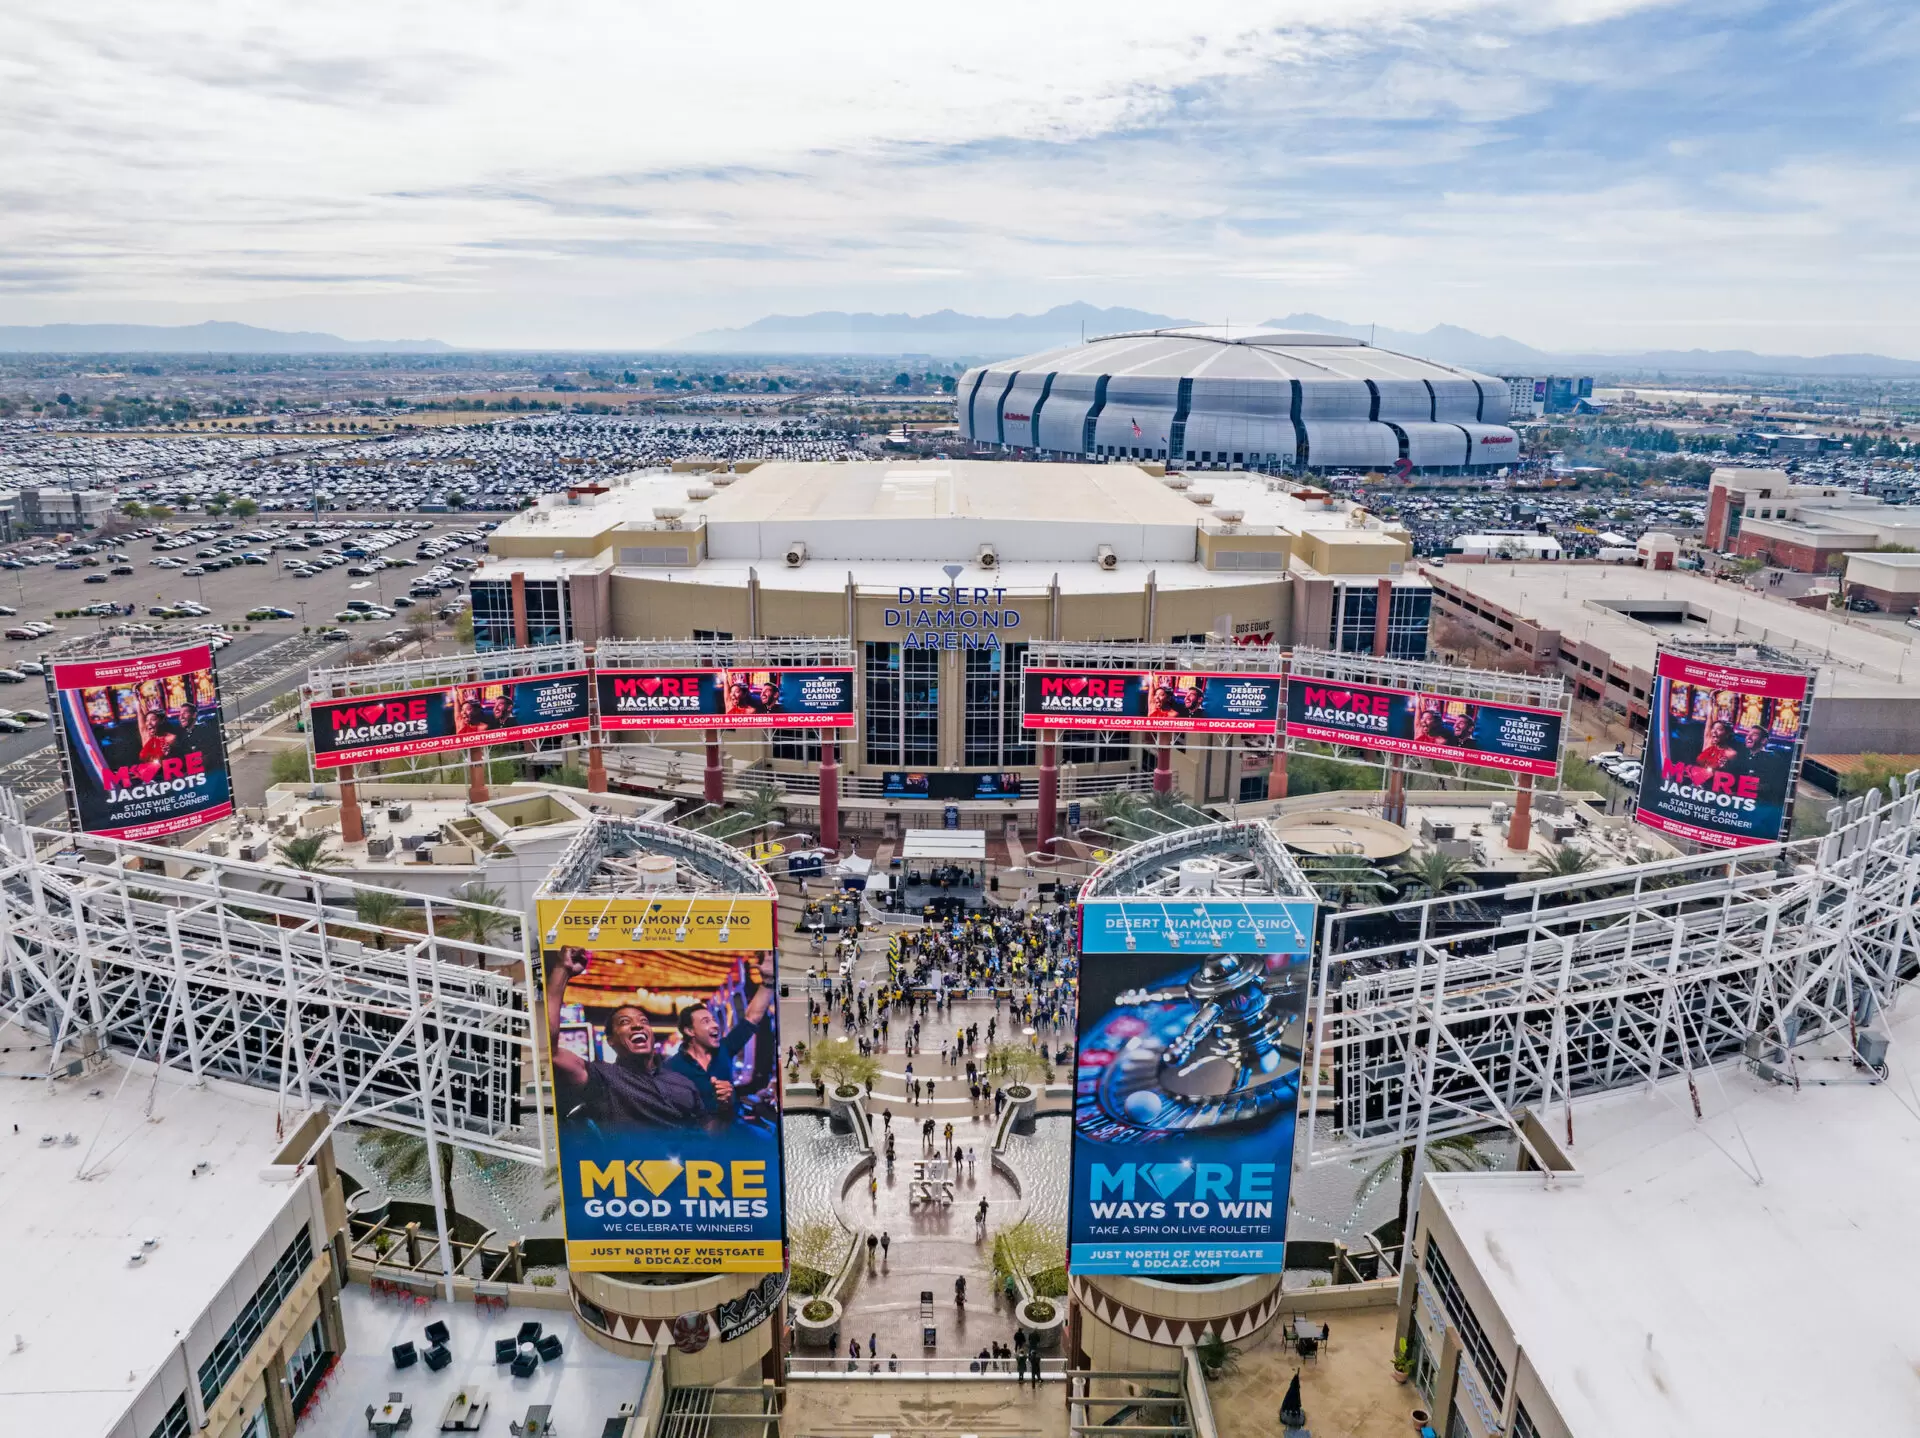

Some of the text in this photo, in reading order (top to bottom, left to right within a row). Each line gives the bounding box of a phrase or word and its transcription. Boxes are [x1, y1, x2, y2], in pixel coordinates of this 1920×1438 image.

[899, 586, 1007, 605] DESERT
[884, 609, 1020, 628] DIAMOND
[1236, 621, 1270, 633] DOS EQUIS
[903, 631, 1001, 650] ARENA
[95, 660, 181, 676] DESERT DIAMOND CASINO
[1685, 667, 1707, 676] DESERT
[1708, 672, 1739, 681] DIAMOND
[536, 692, 577, 703] DIAMOND
[540, 686, 573, 696] DESERT
[541, 700, 573, 708] CASINO
[617, 696, 700, 707] JACKPOTS
[1042, 696, 1123, 708] JACKPOTS
[1305, 706, 1388, 727] JACKPOTS
[334, 719, 428, 741] JACKPOTS
[1505, 720, 1541, 730] DESERT
[1500, 726, 1545, 738] DIAMOND
[340, 750, 374, 759] EXPECT
[376, 744, 401, 755] MORE
[416, 740, 440, 749] LOOP
[463, 731, 507, 742] NORTHERN
[522, 722, 569, 734] DDCAZ.COM
[1504, 734, 1540, 744] CASINO
[1307, 728, 1336, 737] EXPECT
[1338, 732, 1360, 741] MORE
[1375, 738, 1396, 747] LOOP
[1419, 745, 1464, 757] NORTHERN
[1481, 755, 1532, 768] DDCAZ.COM
[1519, 744, 1541, 752] VALLEY
[106, 772, 206, 803] JACKPOTS
[124, 792, 196, 812] STATEWIDE AND
[1660, 780, 1756, 812] JACKPOTS
[110, 794, 209, 820] AROUND THE CORNER!
[1670, 798, 1738, 819] STATEWIDE AND
[1658, 802, 1752, 828] AROUND THE CORNER!
[564, 916, 618, 925] DESERT
[623, 916, 690, 925] DIAMOND
[1106, 919, 1290, 928] DESERT DIAMOND CASINO
[584, 1200, 768, 1218] GOOD TIMES
[1090, 1202, 1272, 1219] WAYS TO WIN
[603, 1224, 753, 1233] WE CELEBRATE WINNERS!
[1089, 1225, 1270, 1234] TAKE A SPIN ON LIVE ROULETTE!
[590, 1248, 764, 1256] JUST NORTH OF WESTGATE
[1090, 1250, 1263, 1259] JUST NORTH OF WESTGATE
[634, 1257, 722, 1265] & DDCAZ.COM
[1132, 1260, 1220, 1268] & DDCAZ.COM
[727, 1310, 767, 1340] JAPANESE
